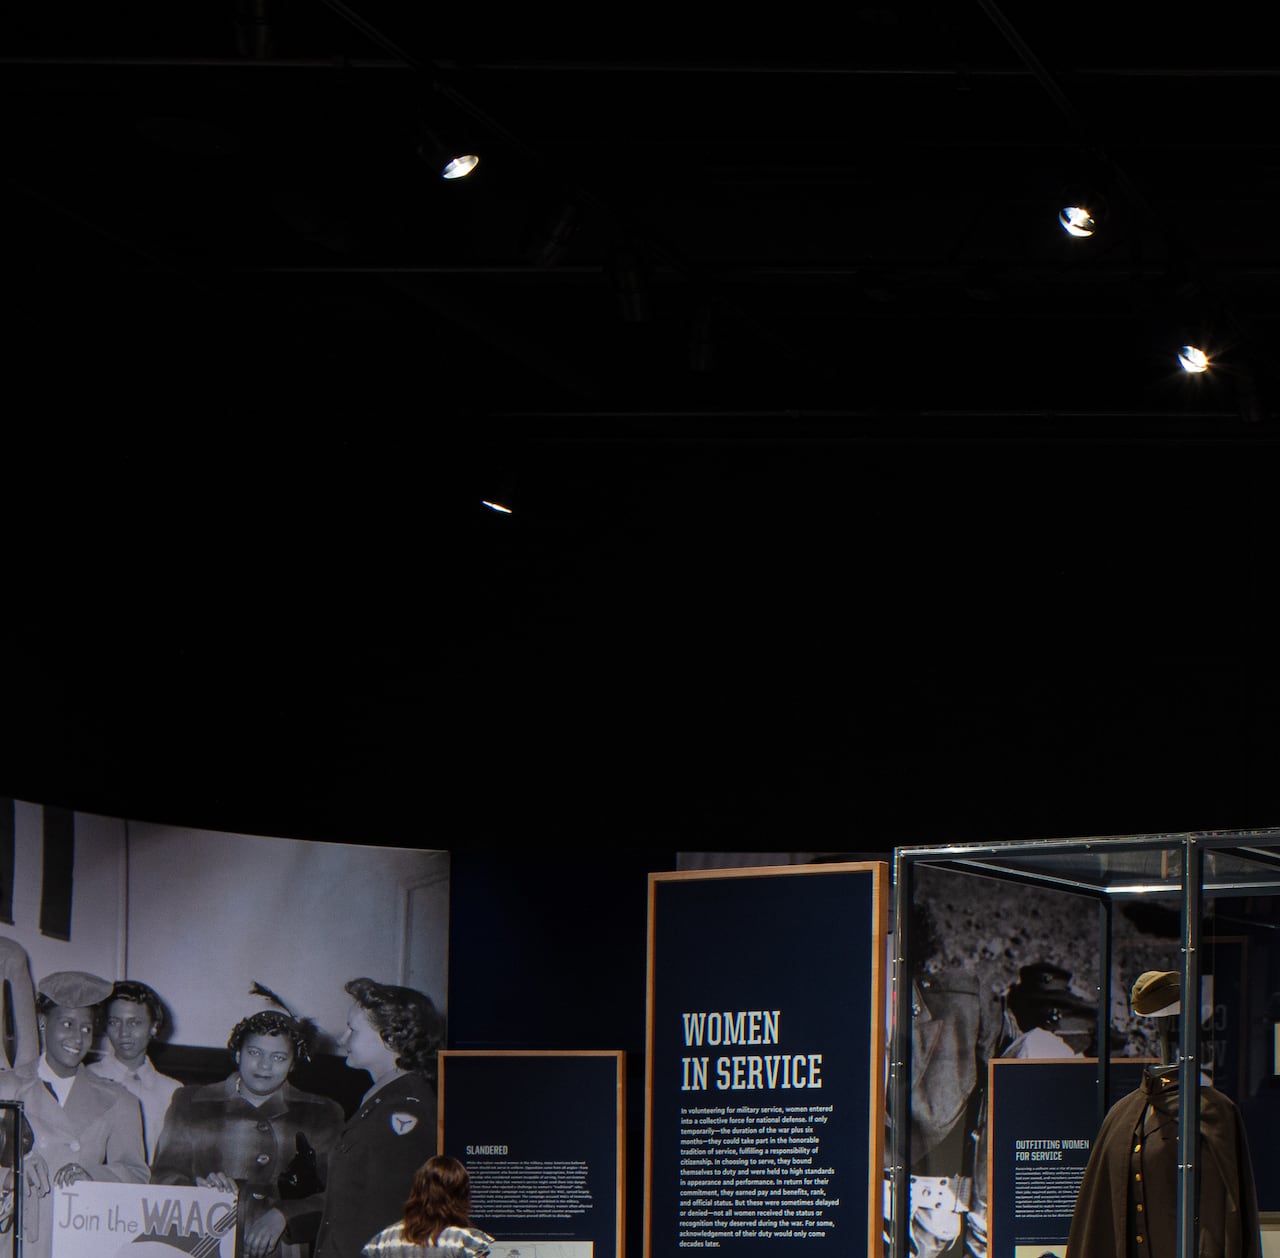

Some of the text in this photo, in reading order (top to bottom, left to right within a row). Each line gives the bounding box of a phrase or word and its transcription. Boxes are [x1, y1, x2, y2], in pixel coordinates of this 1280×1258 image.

[682, 1011, 781, 1046] WOMEN
[681, 1054, 822, 1091] IN SERVICE
[736, 1106, 759, 1114] military
[761, 1106, 784, 1114] service,
[814, 1116, 828, 1124] only
[791, 1126, 804, 1134] plus
[756, 1137, 768, 1145] part
[1016, 1140, 1089, 1149] OUTFITTING WOMEN
[466, 1145, 508, 1155] SLANDERED
[1016, 1151, 1062, 1161] FOR SERVICE
[722, 1158, 748, 1166] choosing
[777, 1158, 791, 1166] they
[722, 1168, 736, 1176] duty
[790, 1168, 803, 1176] high
[720, 1189, 734, 1197] they
[815, 1199, 839, 1207] delayed
[58, 1192, 233, 1239] Join the WAAC
[715, 1220, 728, 1228] they
[758, 1220, 778, 1228] during
[758, 1230, 772, 1238] duty
[794, 1230, 807, 1238] only
